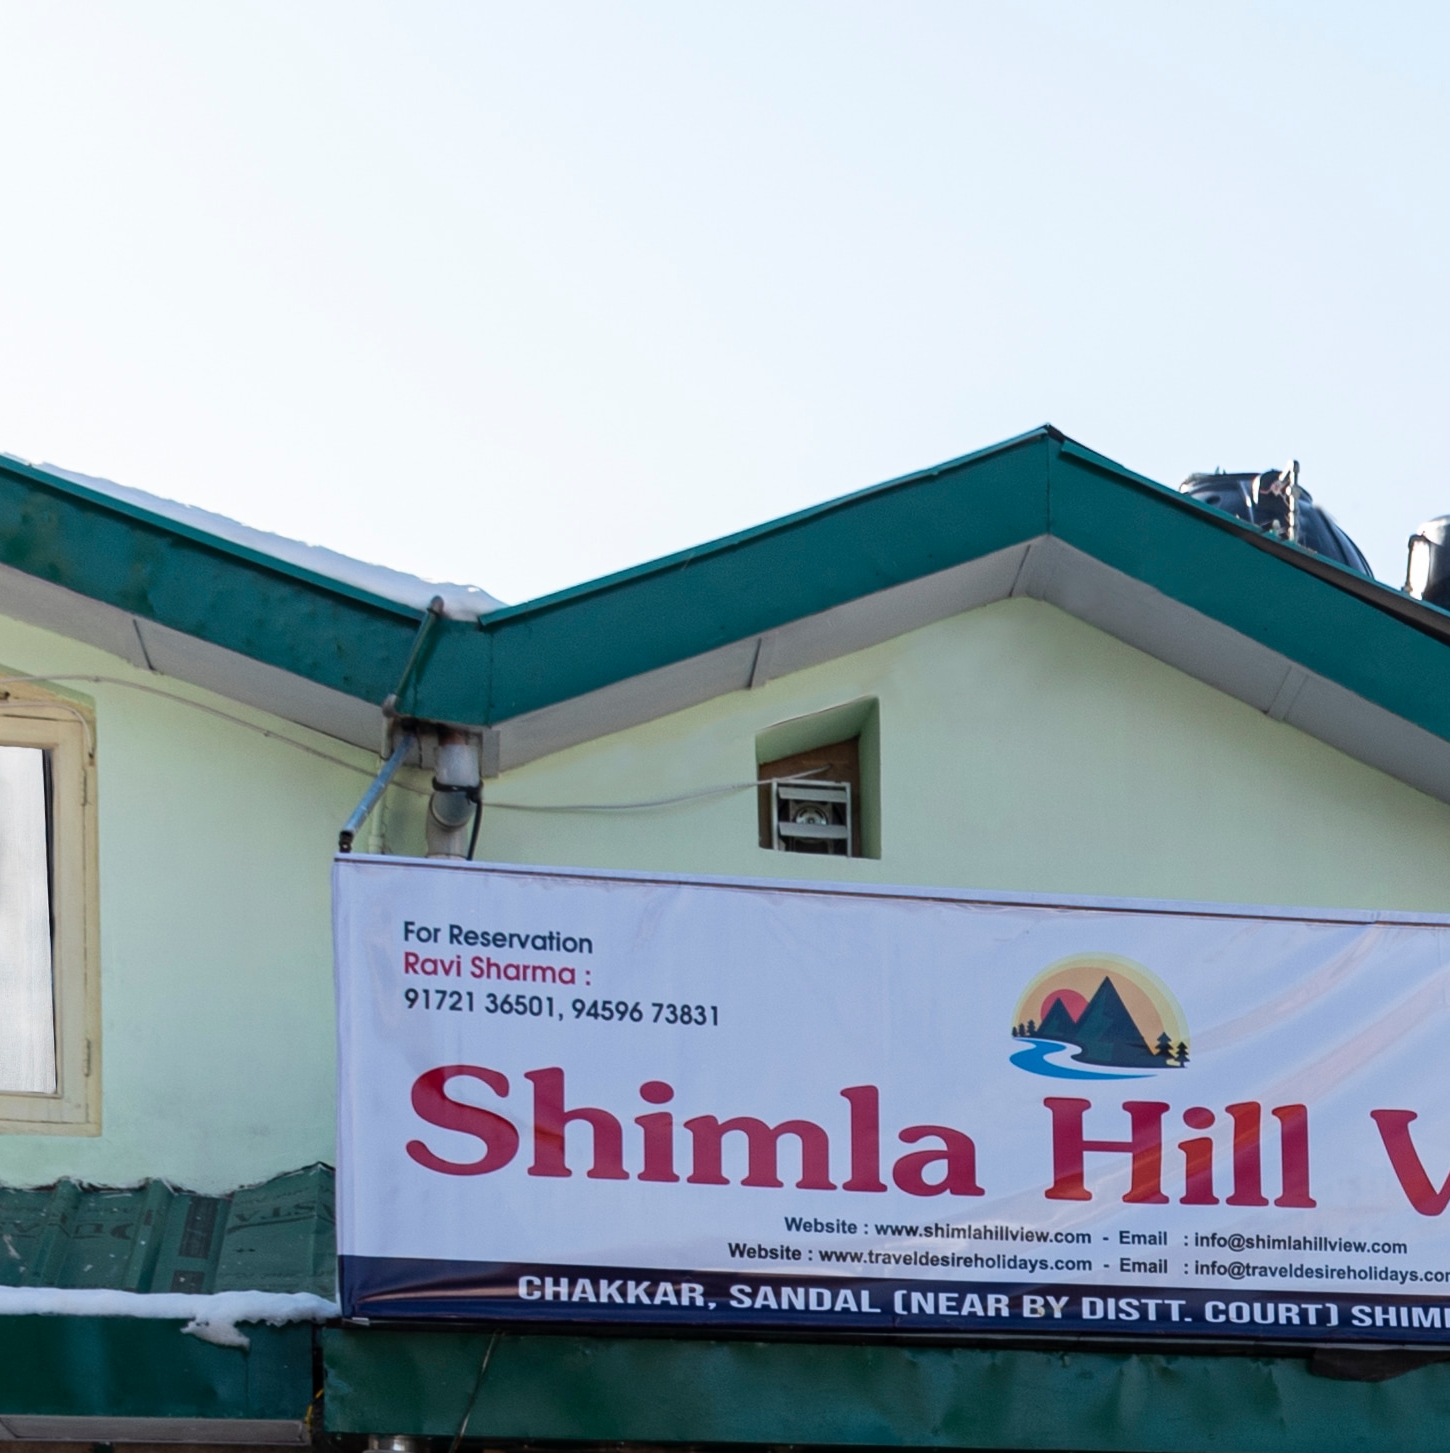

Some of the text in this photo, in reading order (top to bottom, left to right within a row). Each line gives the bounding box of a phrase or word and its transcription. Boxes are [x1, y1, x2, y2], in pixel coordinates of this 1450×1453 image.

[404, 920, 593, 954] For Reservation
[404, 951, 462, 978] Ravi
[470, 955, 576, 985] Sharma
[404, 987, 718, 1026] 91721 36501, 94596 73831
[405, 1064, 986, 1197] Shimla
[1043, 1096, 1317, 1209] Hill
[784, 1216, 858, 1235] Website
[874, 1222, 1092, 1244] www.shimlahillview.com
[1118, 1230, 1168, 1246] Email
[1194, 1232, 1408, 1254] info@shimlahillview.com
[727, 1242, 802, 1261] Website
[818, 1249, 1093, 1274] www.traveldesireholidays.com
[1119, 1257, 1168, 1274] Email
[517, 1275, 717, 1310] CHAKKAR,
[729, 1284, 882, 1313] SANDAL
[1022, 1294, 1070, 1319] BY
[1081, 1296, 1192, 1322] DISTT.
